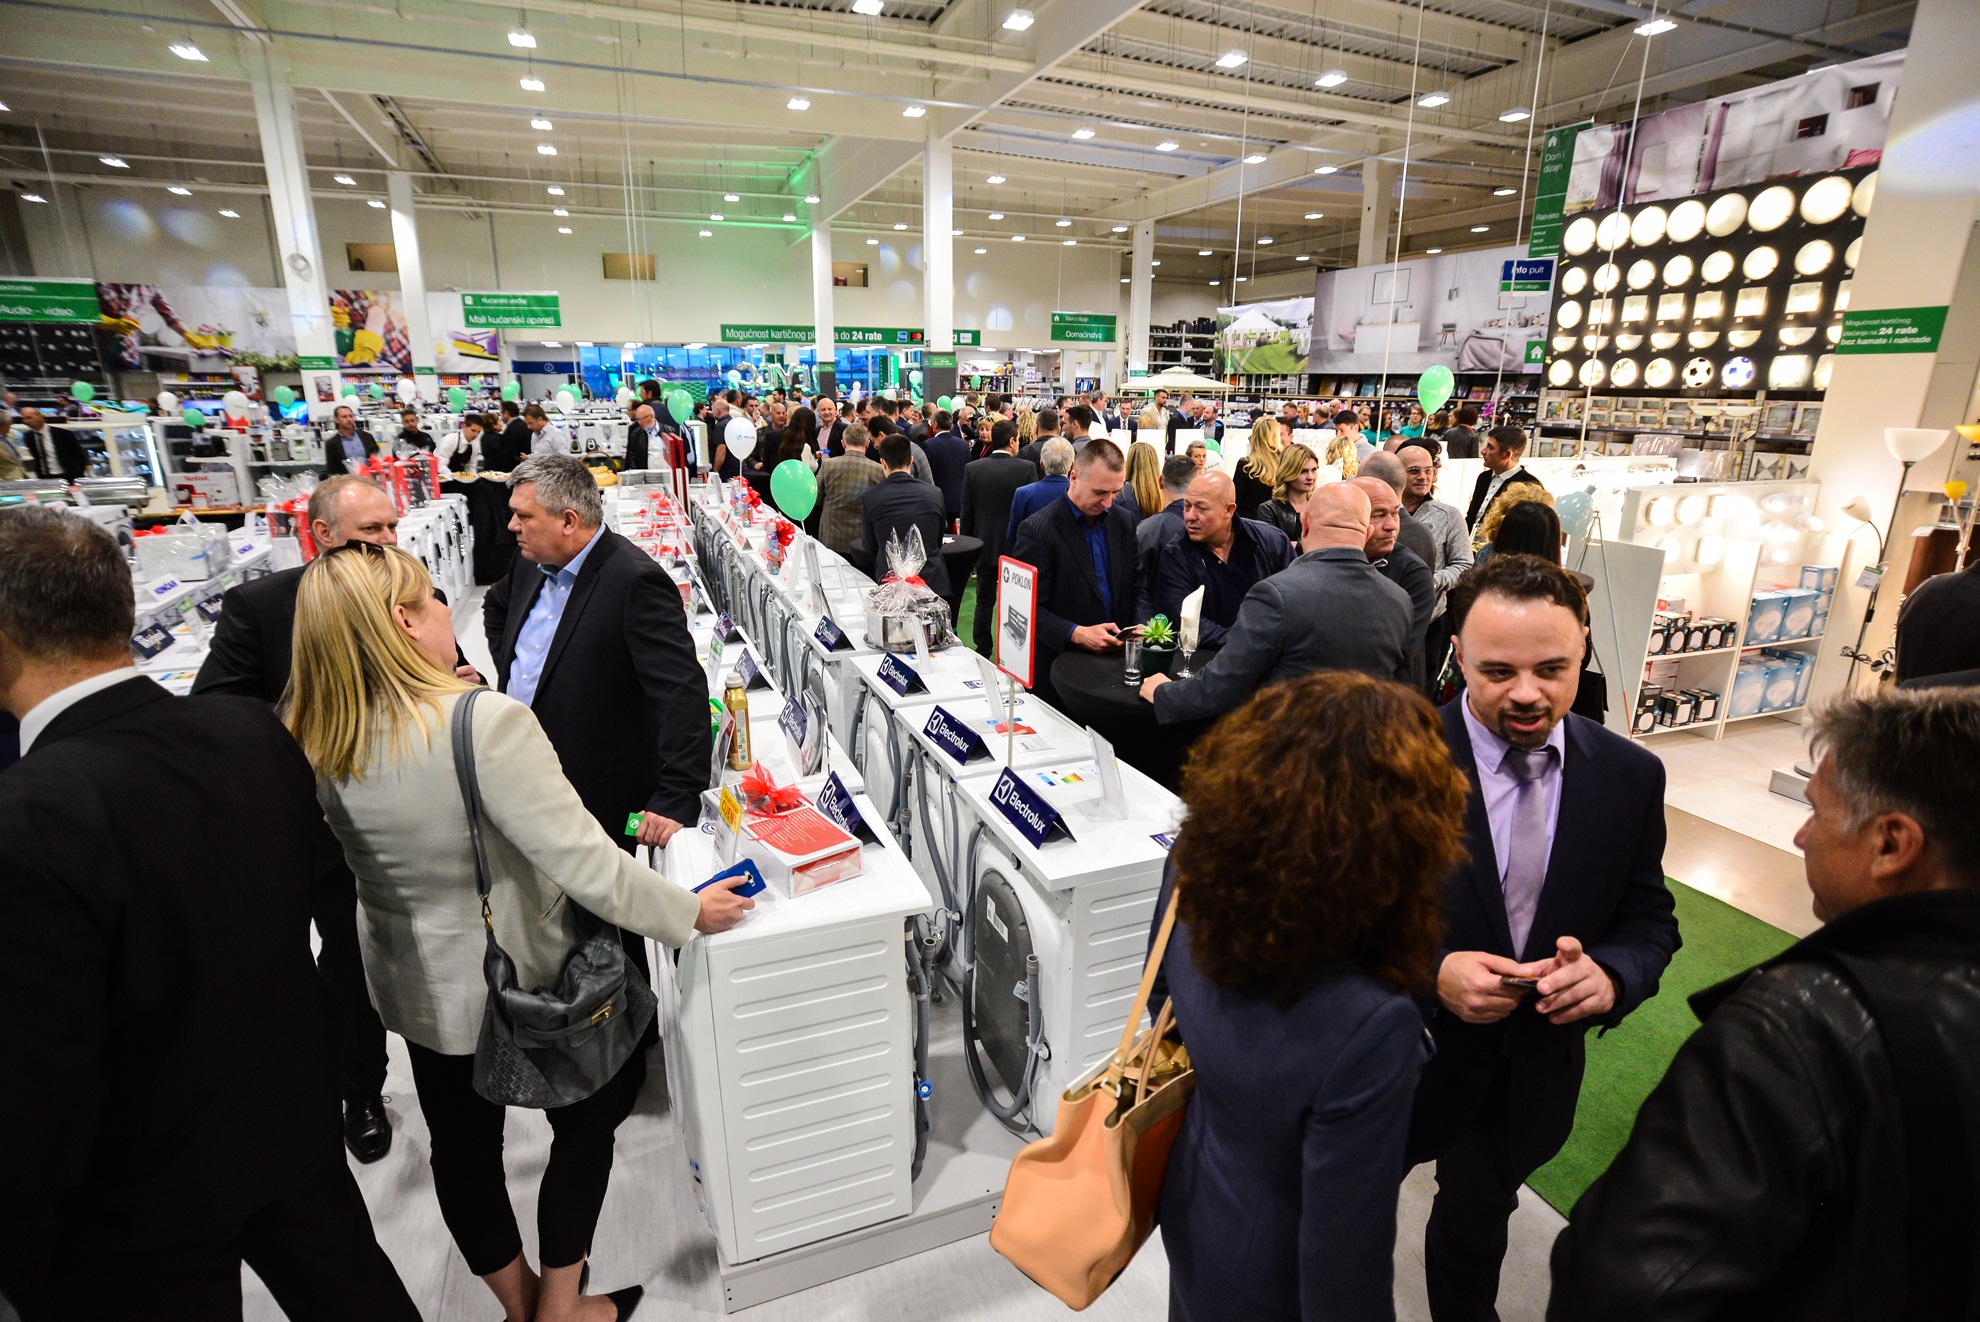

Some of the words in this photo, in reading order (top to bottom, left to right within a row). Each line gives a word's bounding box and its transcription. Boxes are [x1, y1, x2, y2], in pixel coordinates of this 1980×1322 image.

[1545, 153, 1561, 163] Dom
[1543, 163, 1562, 173] dizajn
[1529, 265, 1545, 275] pult
[468, 315, 486, 323] Mali
[488, 314, 525, 324] kućanski
[526, 316, 555, 325] aparati
[725, 328, 769, 341] Mogućnost
[771, 329, 805, 342] kartičnog
[840, 331, 850, 340] do
[852, 331, 863, 340] 24
[865, 332, 883, 341] rate
[1065, 330, 1102, 339] Domaćinstvo
[1878, 327, 1893, 335] 24
[1894, 326, 1919, 334] rate
[1011, 572, 1032, 591] POKLON
[888, 664, 909, 687] Electrolux
[787, 711, 803, 740] Electrolux
[939, 722, 970, 754] Electrolux
[1008, 791, 1046, 834] Electrolux
